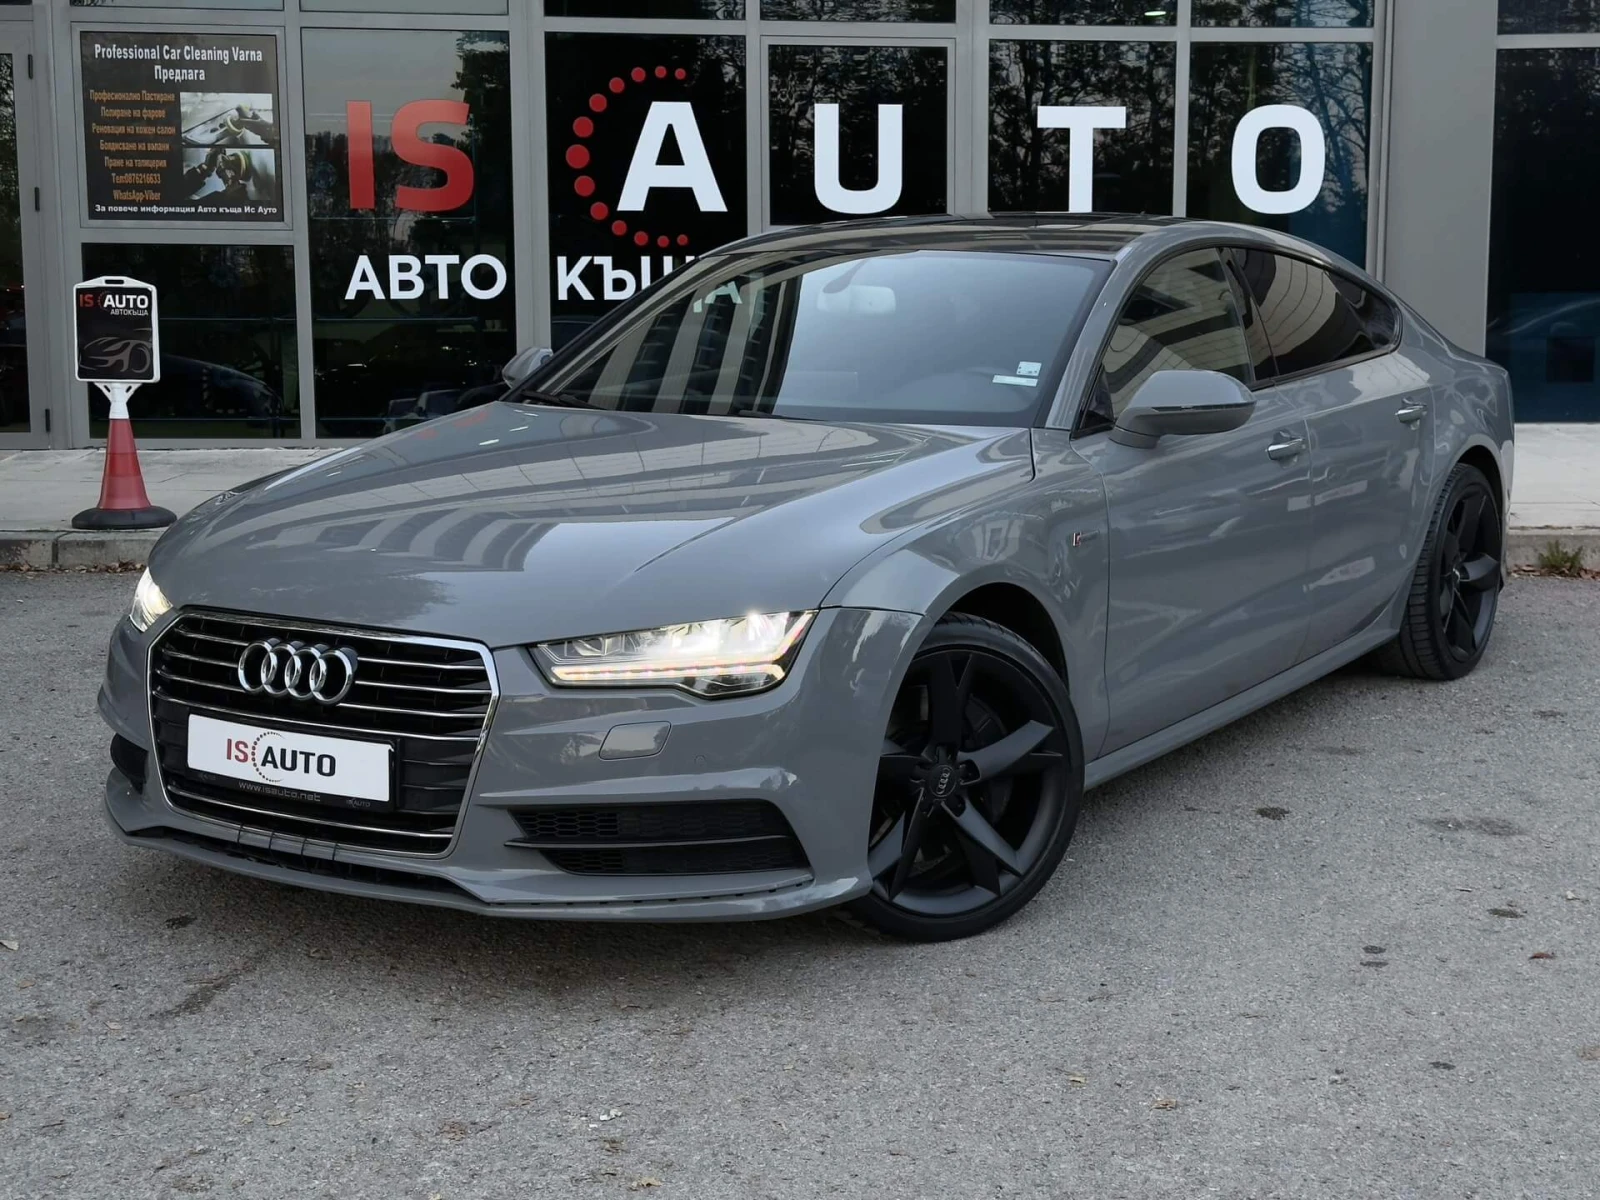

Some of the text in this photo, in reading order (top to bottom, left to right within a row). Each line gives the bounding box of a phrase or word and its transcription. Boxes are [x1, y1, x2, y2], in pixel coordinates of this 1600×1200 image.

[94, 43, 263, 65] Professional Car Cleaning Varna
[154, 65, 206, 83] Предлага
[90, 90, 140, 103] Професионално
[133, 109, 141, 117] на
[126, 126, 135, 134] на
[157, 126, 176, 135] салон
[138, 142, 146, 151] на
[346, 99, 474, 212] IS
[104, 156, 125, 170] Пране
[125, 159, 134, 167] на
[95, 204, 106, 212] За
[140, 205, 196, 214] информация
[197, 205, 217, 213] Авто
[257, 206, 278, 215] Ауто
[344, 254, 507, 300] АВТО
[79, 294, 149, 309] IS AUTO
[110, 308, 149, 316] АВТОКЪЩА
[226, 738, 336, 777] IS AUTO
[238, 780, 321, 802] www.isauto.net
